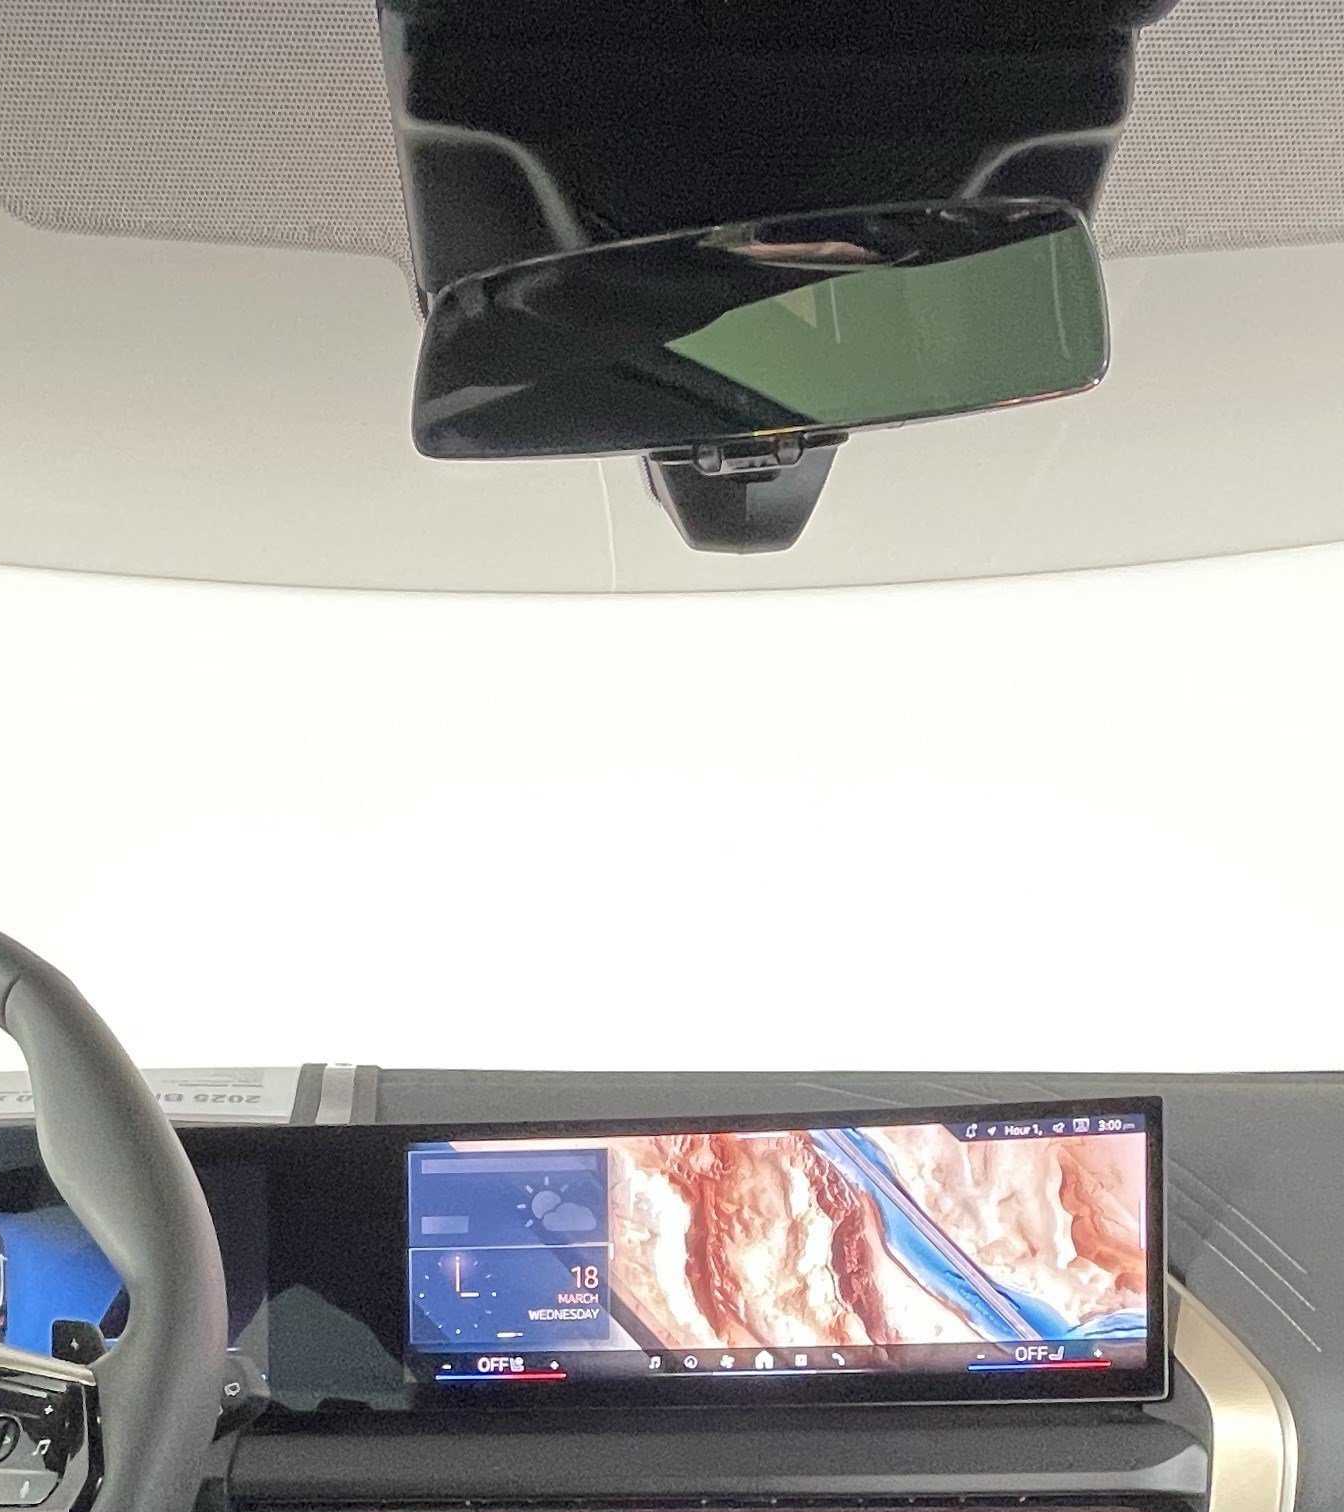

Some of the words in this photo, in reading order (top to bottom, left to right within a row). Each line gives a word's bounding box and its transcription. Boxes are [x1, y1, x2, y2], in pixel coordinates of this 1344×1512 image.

[193, 1093, 261, 1104] 2025
[1097, 1119, 1122, 1132] 3:00
[570, 1265, 599, 1289] 18
[557, 1292, 599, 1305] MARCH
[527, 1307, 600, 1322] WEDNESDAY
[1014, 1345, 1049, 1362] OFF
[477, 1357, 510, 1373] OFF
